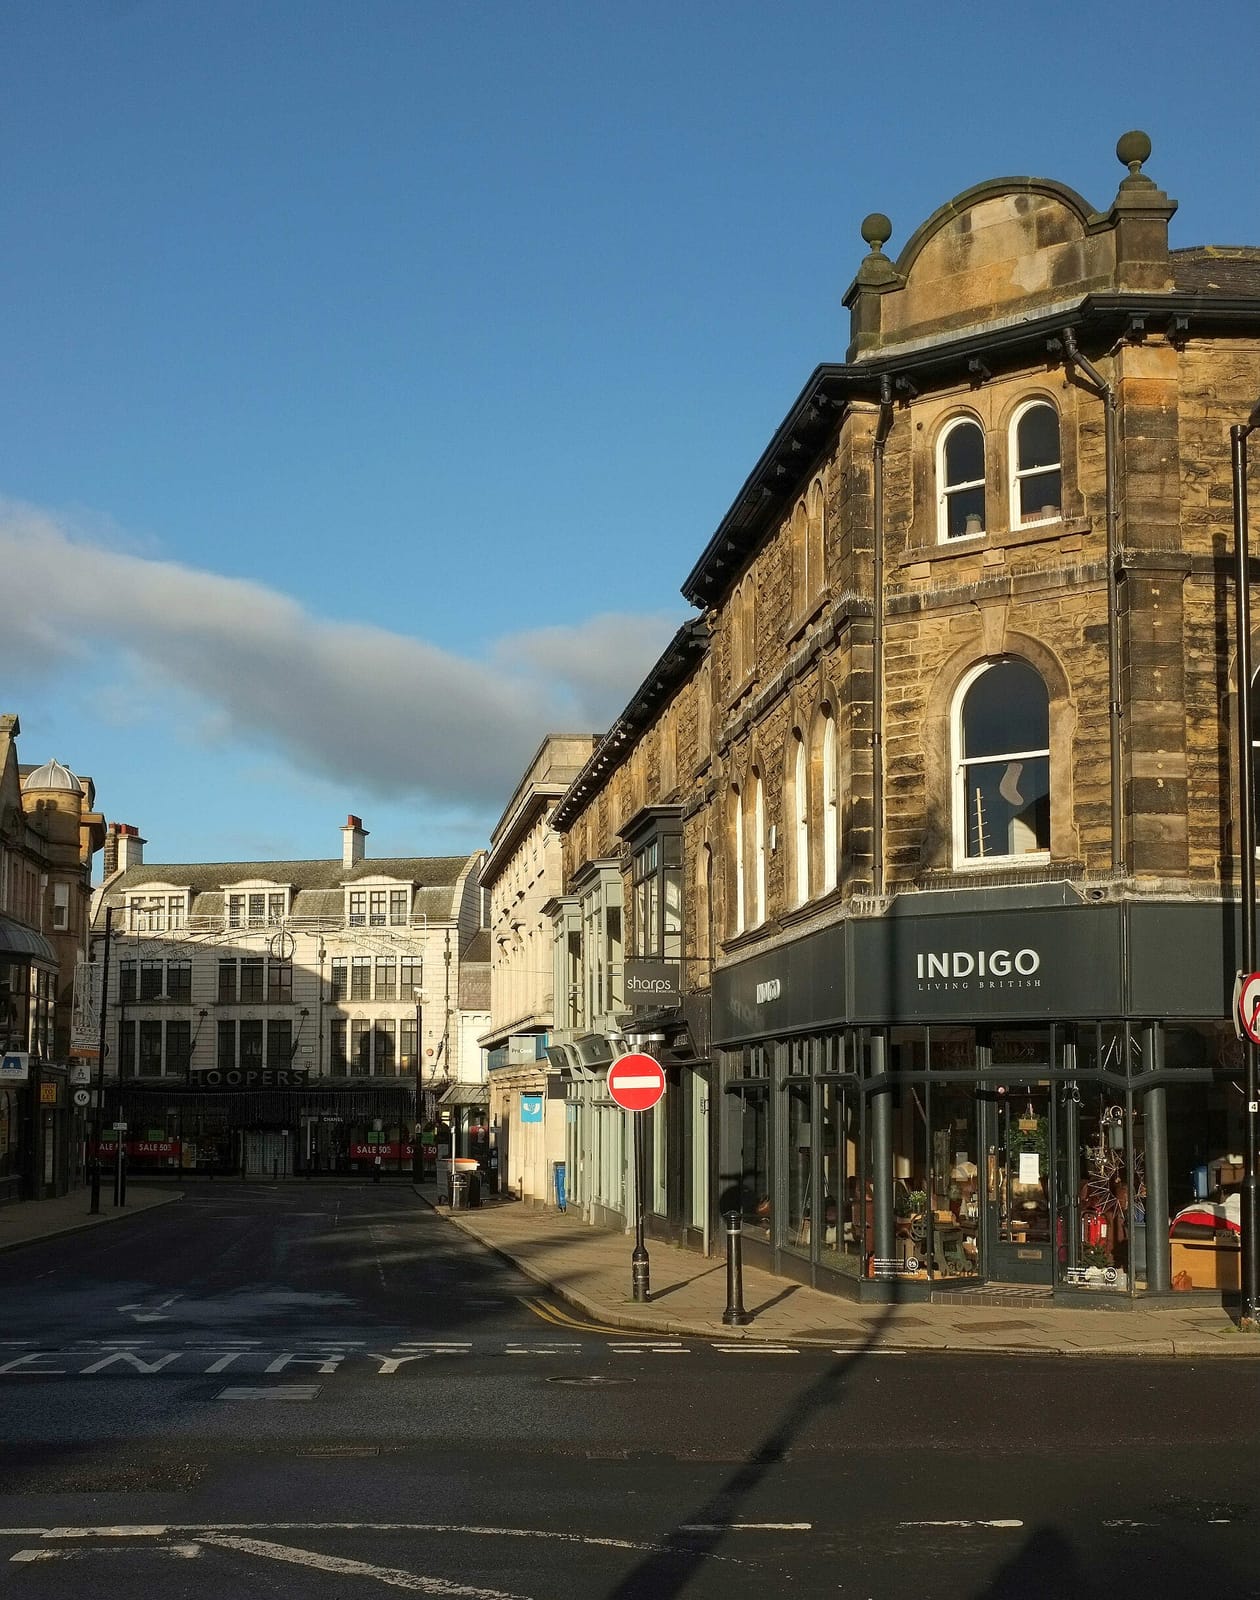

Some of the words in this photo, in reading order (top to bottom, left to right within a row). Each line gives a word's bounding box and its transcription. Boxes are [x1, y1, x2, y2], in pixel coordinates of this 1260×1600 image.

[917, 948, 1041, 979] INDIGO
[626, 975, 671, 993] sharps
[918, 982, 969, 991] LIVING
[979, 979, 1042, 989] BRITISH
[190, 1070, 304, 1085] HOOPERS
[99, 1143, 113, 1151] ALE
[138, 1143, 158, 1152] SALE
[356, 1145, 377, 1154] SALE
[0, 1352, 428, 1375] ENTRY
